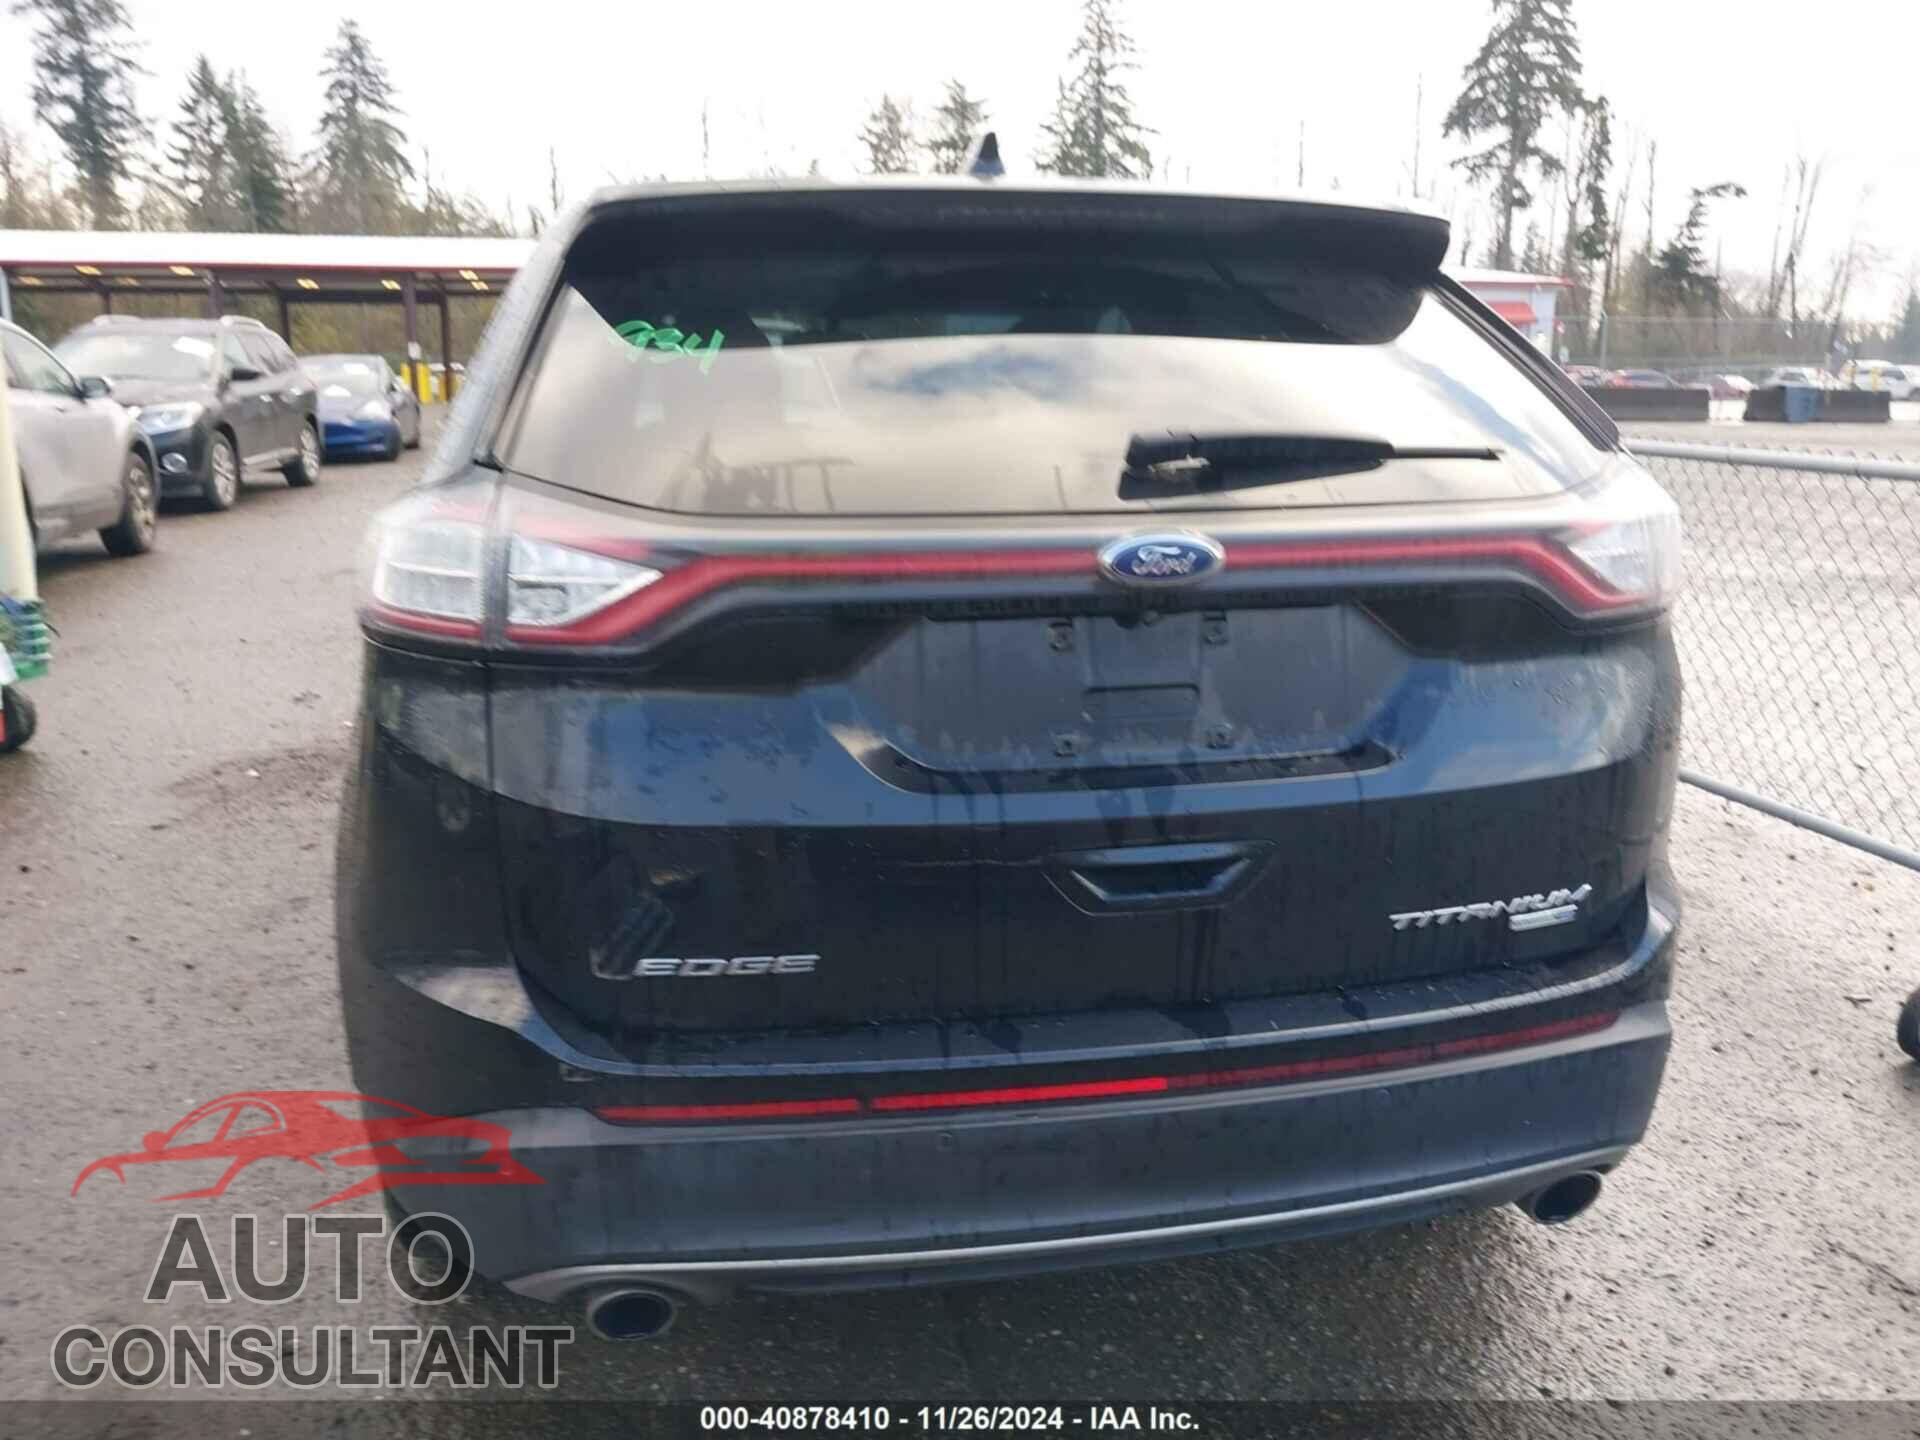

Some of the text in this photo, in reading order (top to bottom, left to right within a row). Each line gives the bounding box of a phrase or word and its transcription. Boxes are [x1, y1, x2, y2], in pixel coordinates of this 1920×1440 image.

[1131, 545, 1198, 576] Ford
[1388, 883, 1593, 931] TITANIUM
[632, 954, 822, 976] EDGE
